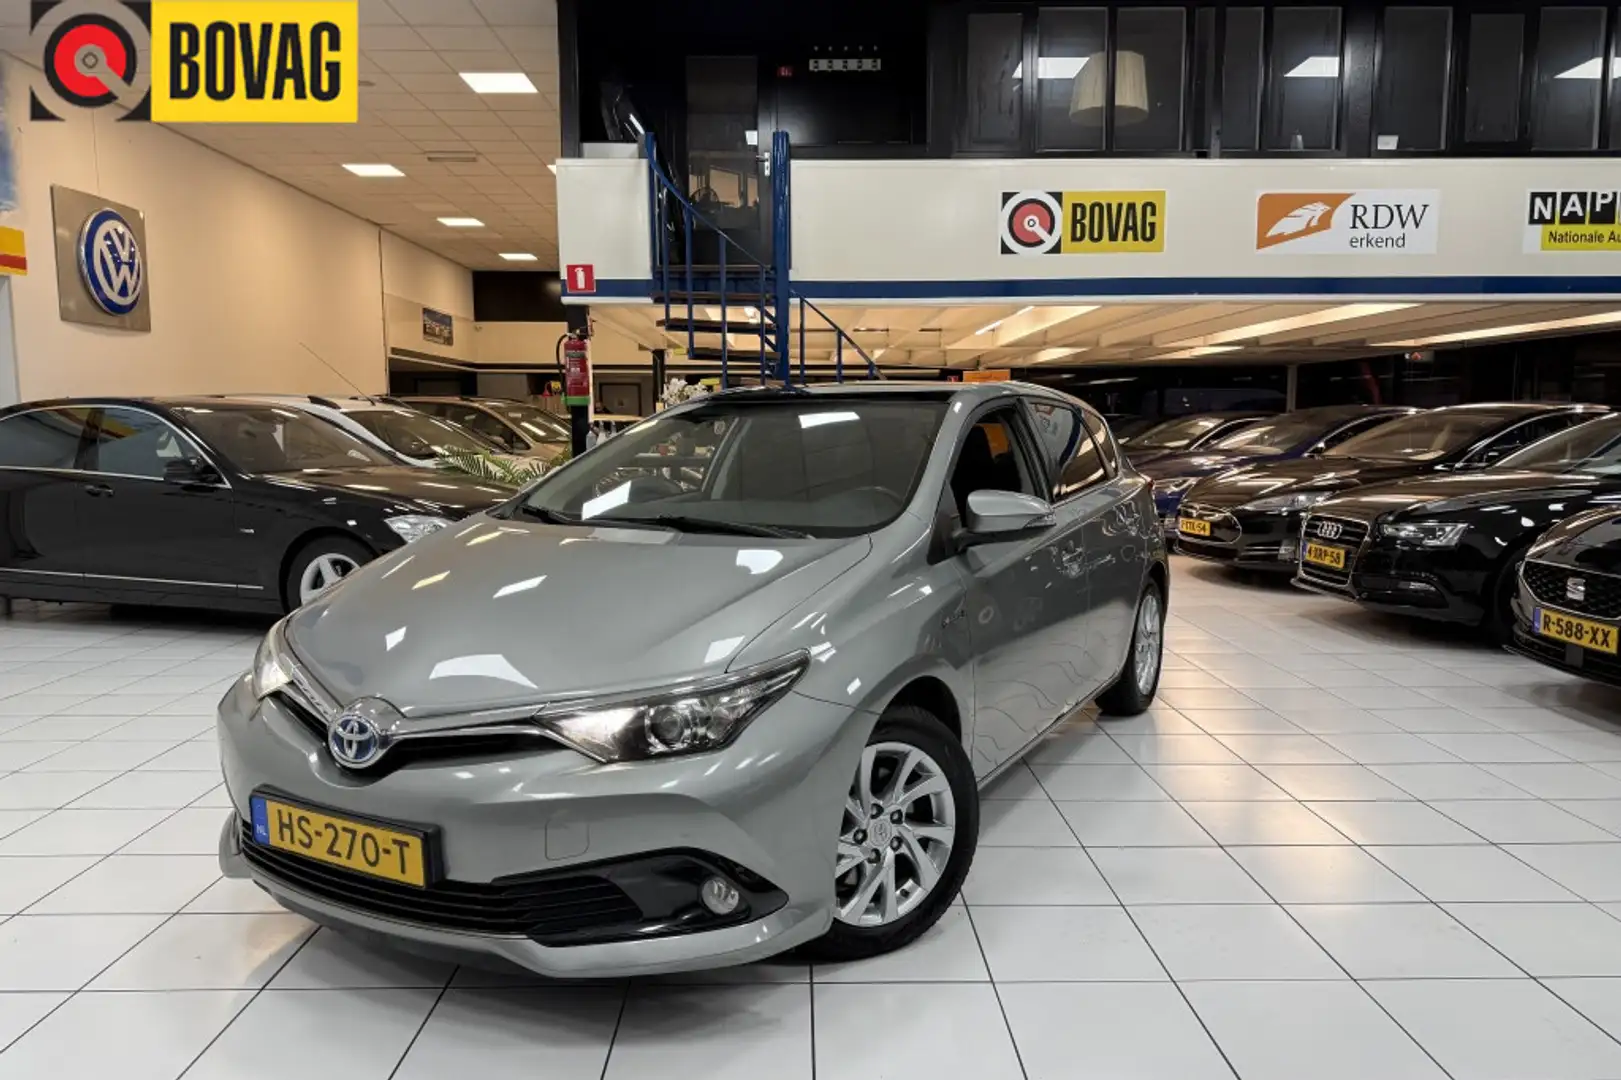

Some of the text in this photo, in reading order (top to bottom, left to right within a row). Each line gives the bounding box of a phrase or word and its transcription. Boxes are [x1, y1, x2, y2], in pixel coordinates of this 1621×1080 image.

[1349, 204, 1430, 230] RDW
[1533, 191, 1614, 220] NAP
[1070, 201, 1157, 243] BOVAG
[1349, 233, 1406, 249] erkend
[1548, 230, 1604, 244] Nationale
[1543, 613, 1611, 648] R-588-XX
[277, 808, 410, 876] HS-270-T
